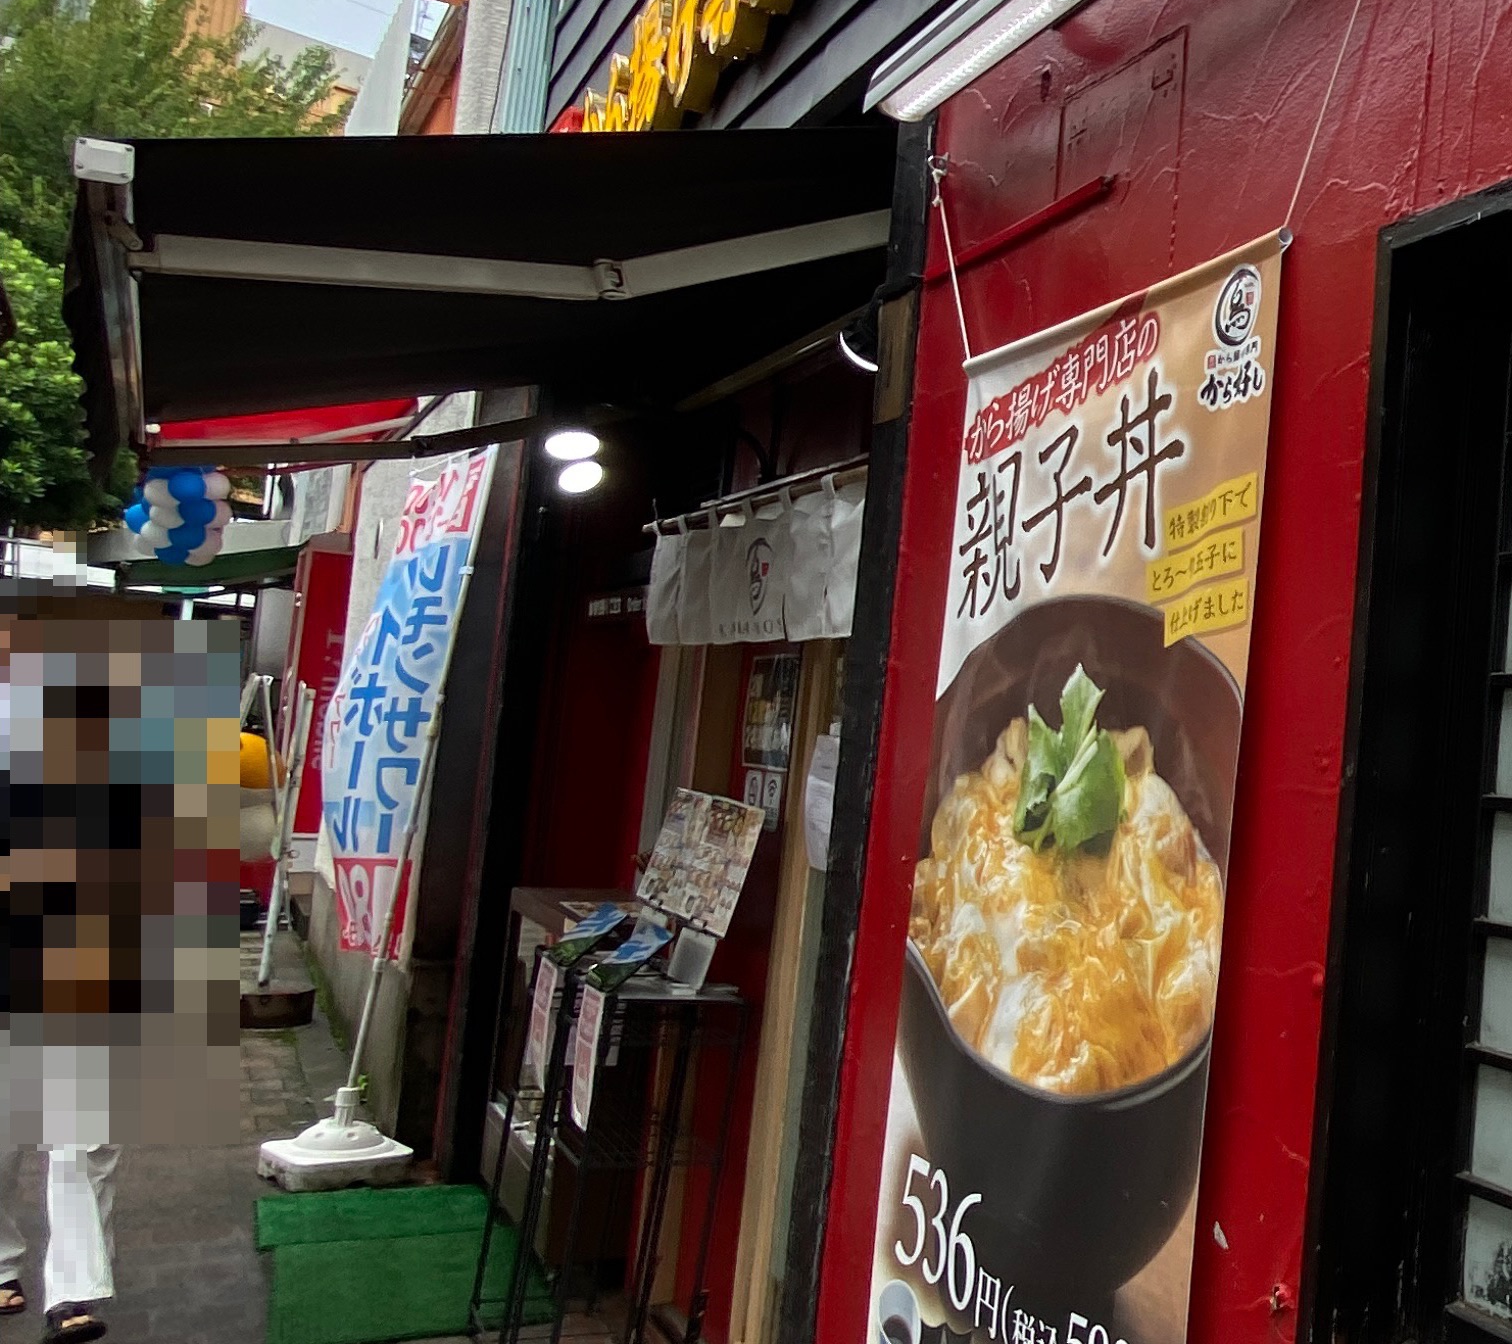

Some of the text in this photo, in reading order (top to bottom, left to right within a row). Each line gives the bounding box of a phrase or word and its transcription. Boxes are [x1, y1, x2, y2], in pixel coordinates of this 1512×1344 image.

[970, 318, 1158, 459] から揚げ専門店の
[957, 367, 1184, 620] 親子丼
